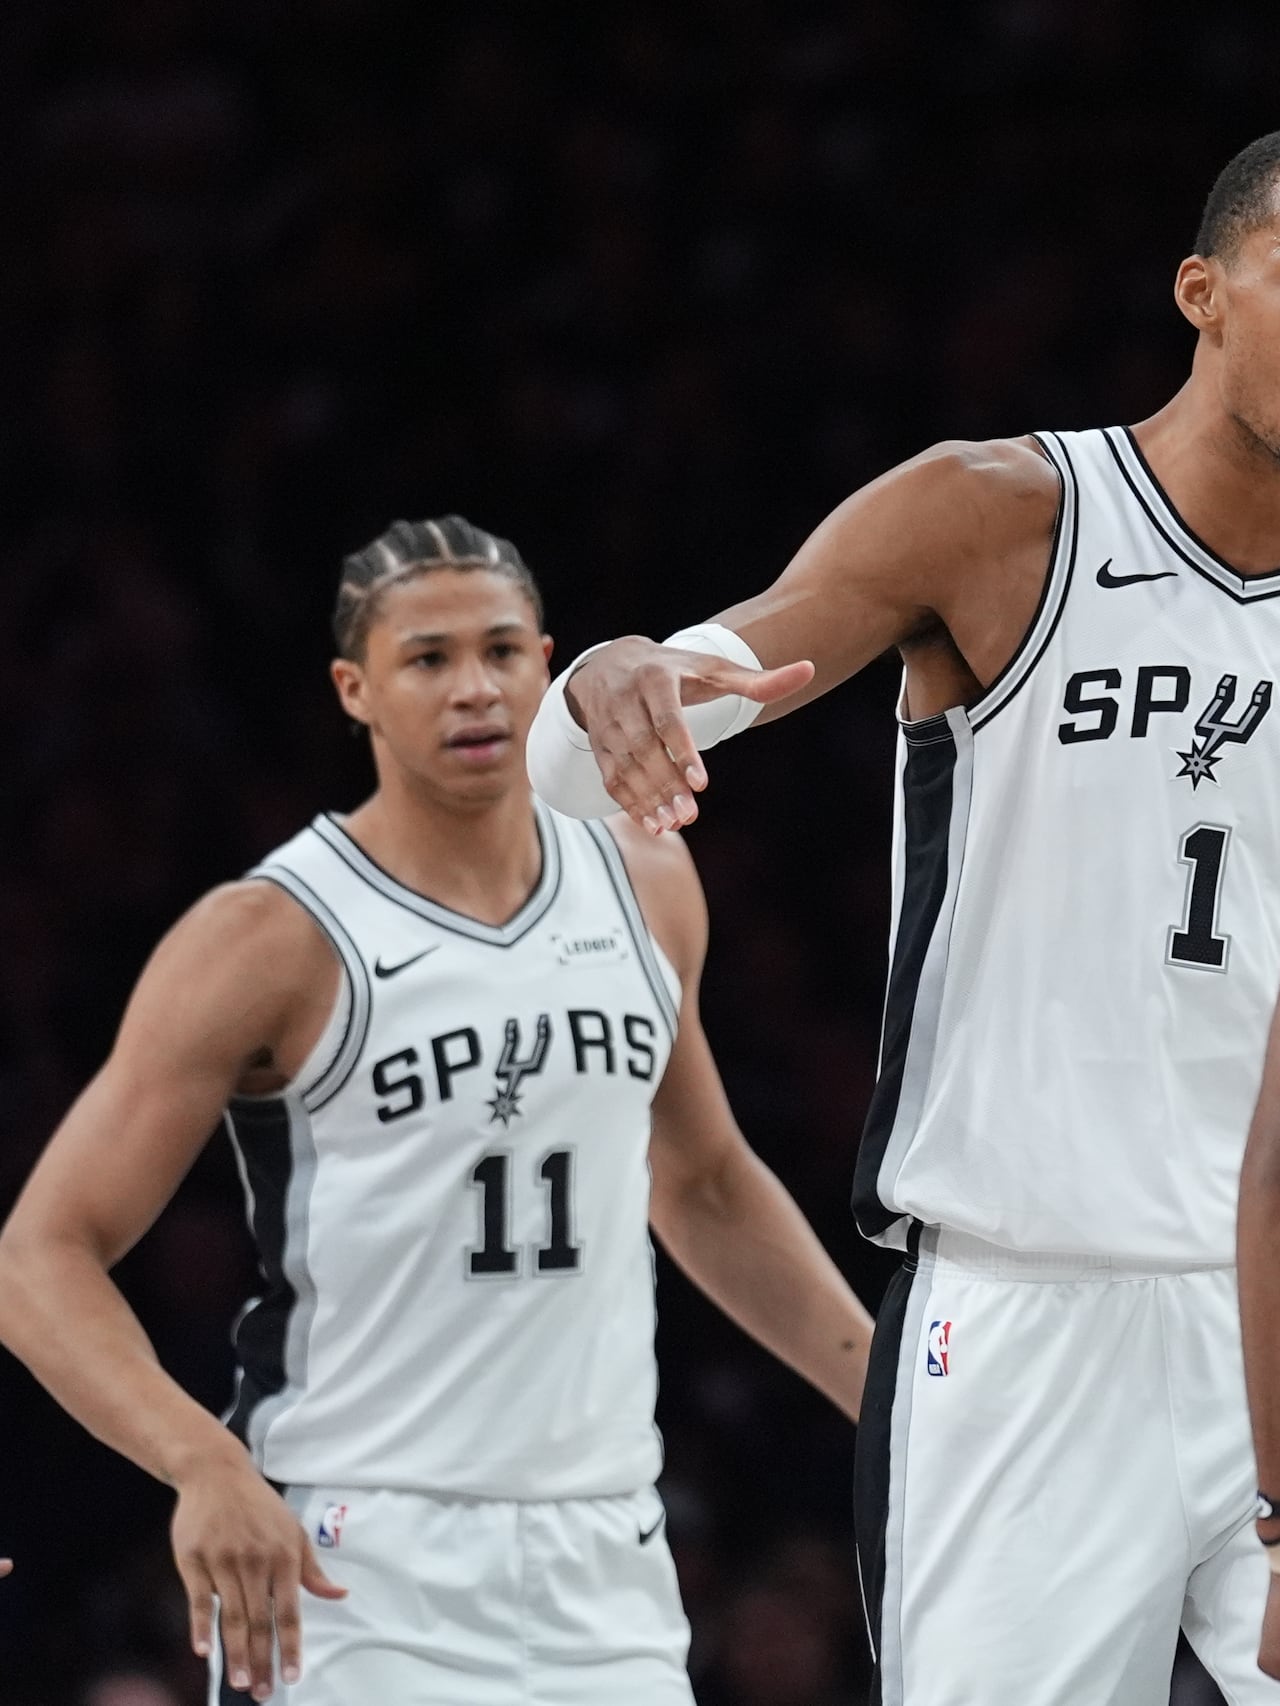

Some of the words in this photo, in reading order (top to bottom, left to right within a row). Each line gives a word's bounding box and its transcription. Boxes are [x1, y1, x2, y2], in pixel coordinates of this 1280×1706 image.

[1165, 822, 1232, 973] 1
[372, 1010, 657, 1128] SPURS
[465, 1145, 585, 1281] 11
